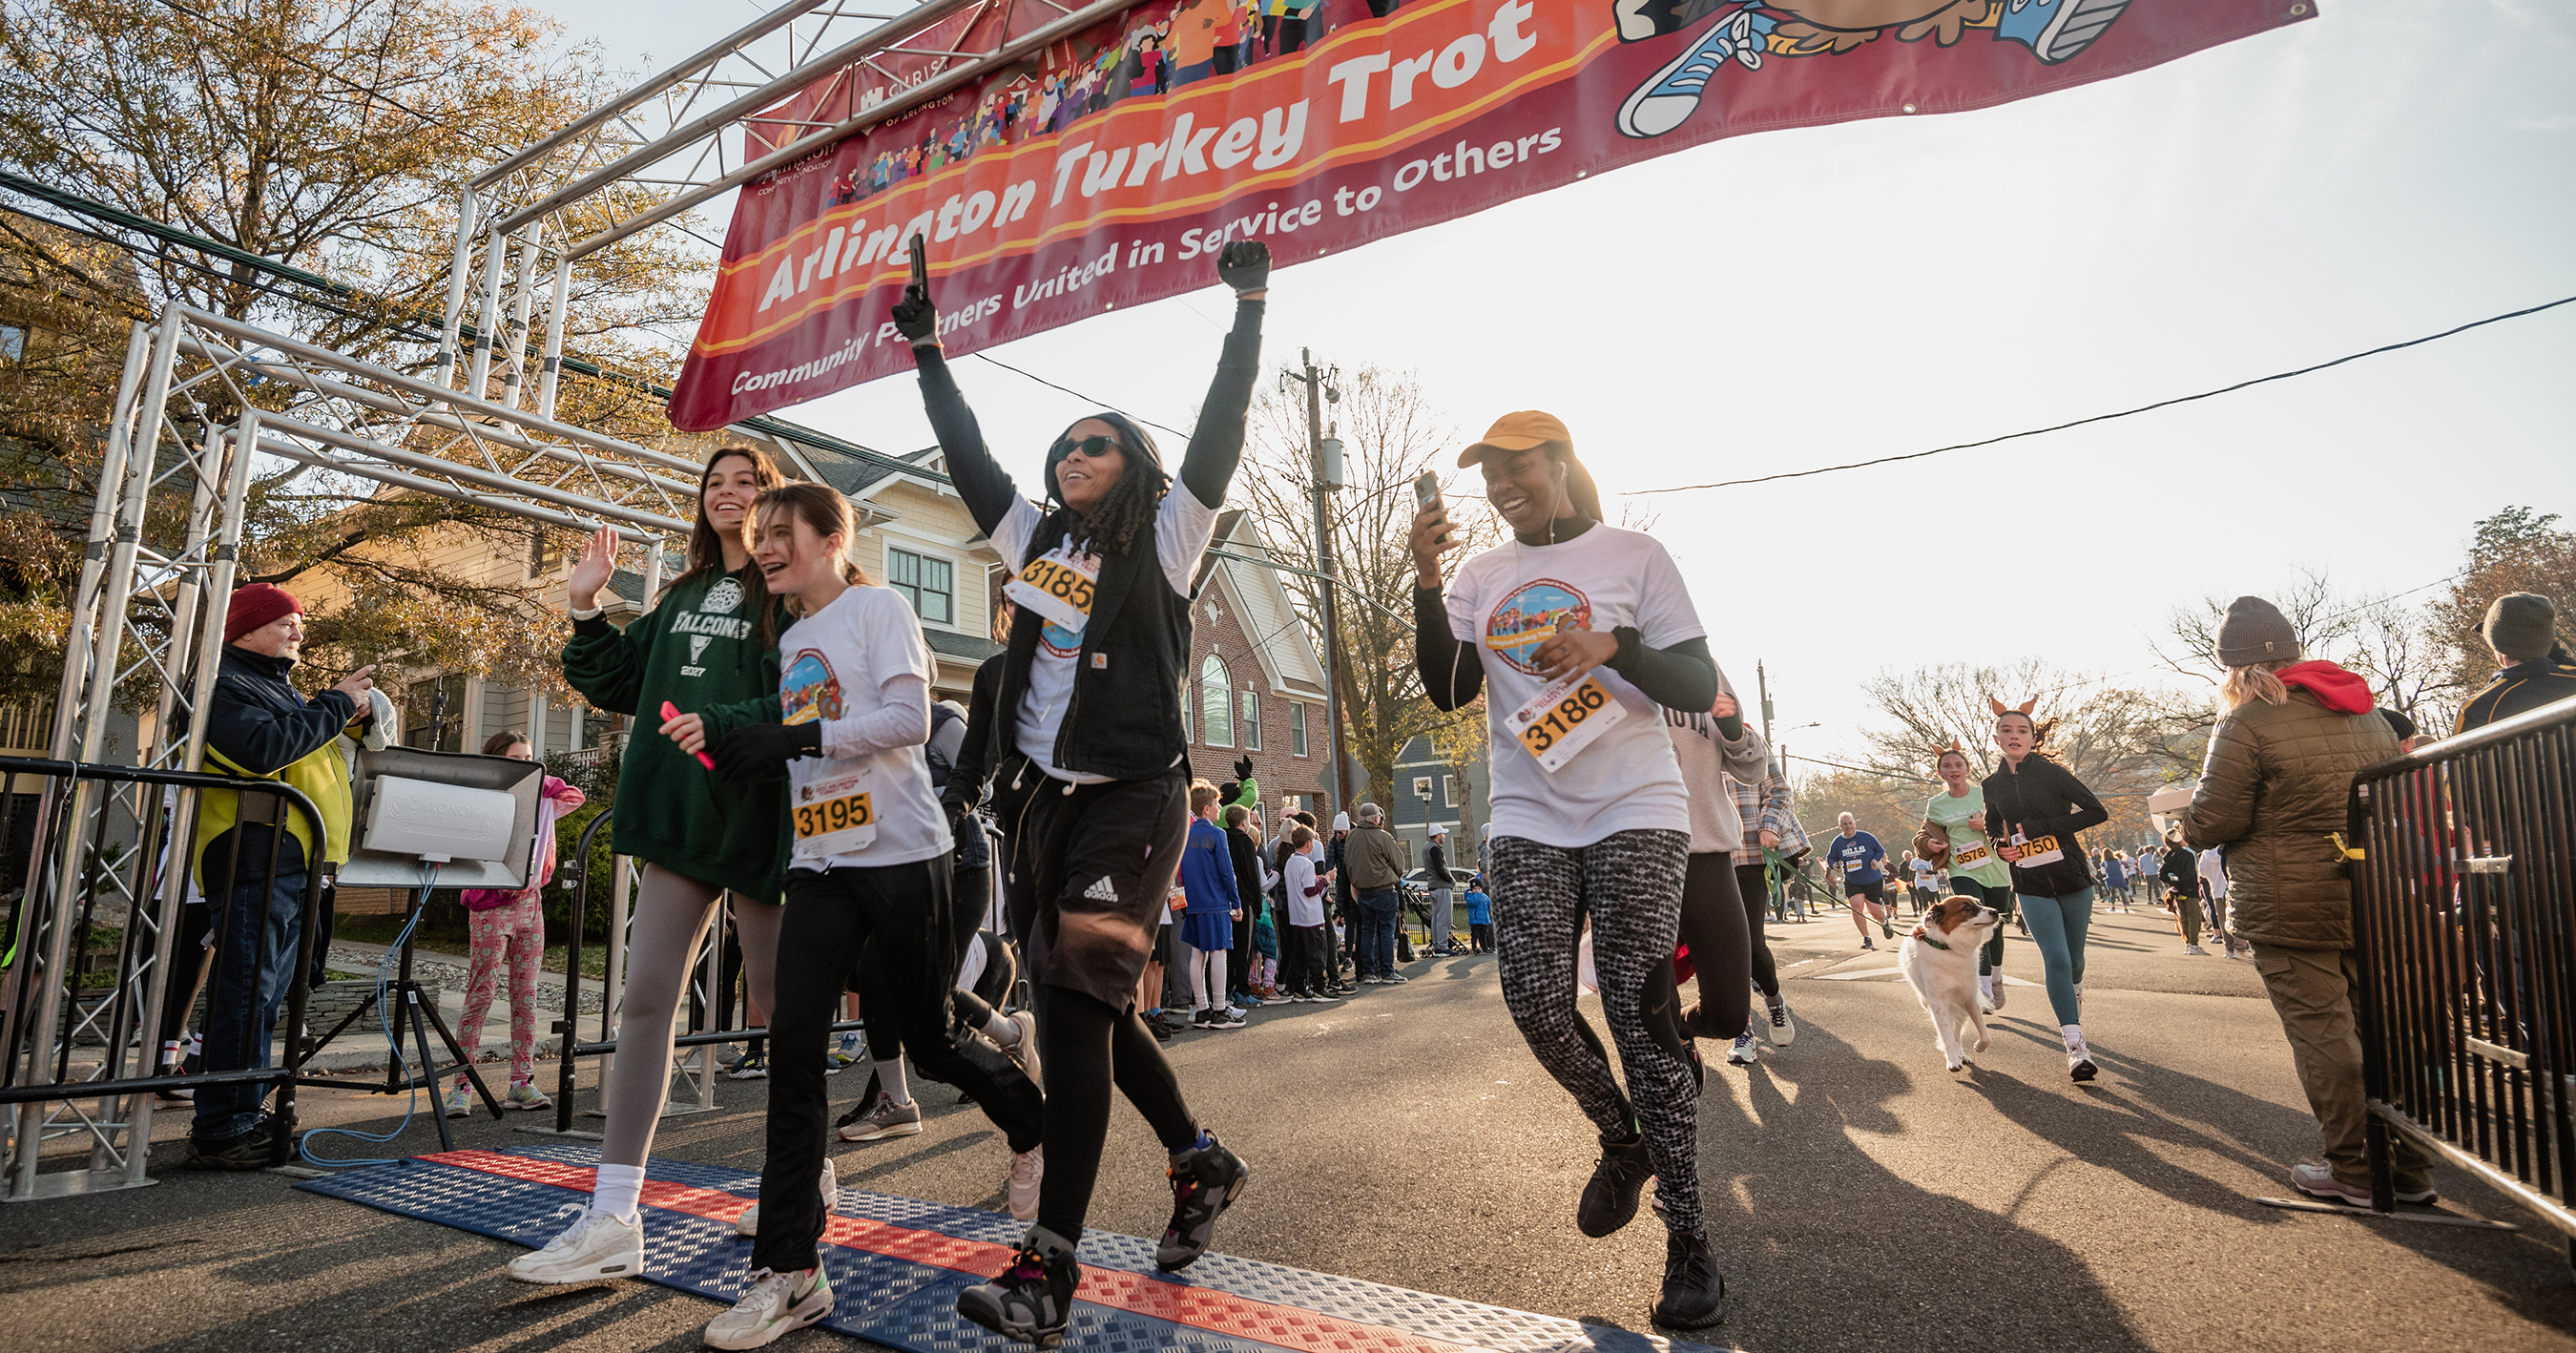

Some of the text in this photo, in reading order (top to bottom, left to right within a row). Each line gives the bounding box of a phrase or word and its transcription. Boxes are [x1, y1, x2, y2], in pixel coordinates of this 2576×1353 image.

[885, 93, 954, 127] OF ARLINGTON
[758, 0, 1537, 313] Arlington Turkey Trot
[731, 332, 870, 396] Community
[1012, 241, 1119, 310] United
[1128, 239, 1165, 269] in
[1178, 198, 1322, 260] Service
[1334, 185, 1382, 217] to
[1393, 127, 1562, 193] Others
[1024, 560, 1097, 609] 3185
[670, 611, 753, 641] FALCONS
[680, 666, 706, 677] 2027
[1527, 684, 1604, 751] 3186
[410, 798, 510, 822] CHRONOTRACK
[799, 794, 867, 837] 3195
[1841, 845, 1866, 857] BILLS
[1957, 847, 1986, 865] 3578
[2016, 837, 2055, 859] 3750
[1084, 888, 1119, 904] adidas
